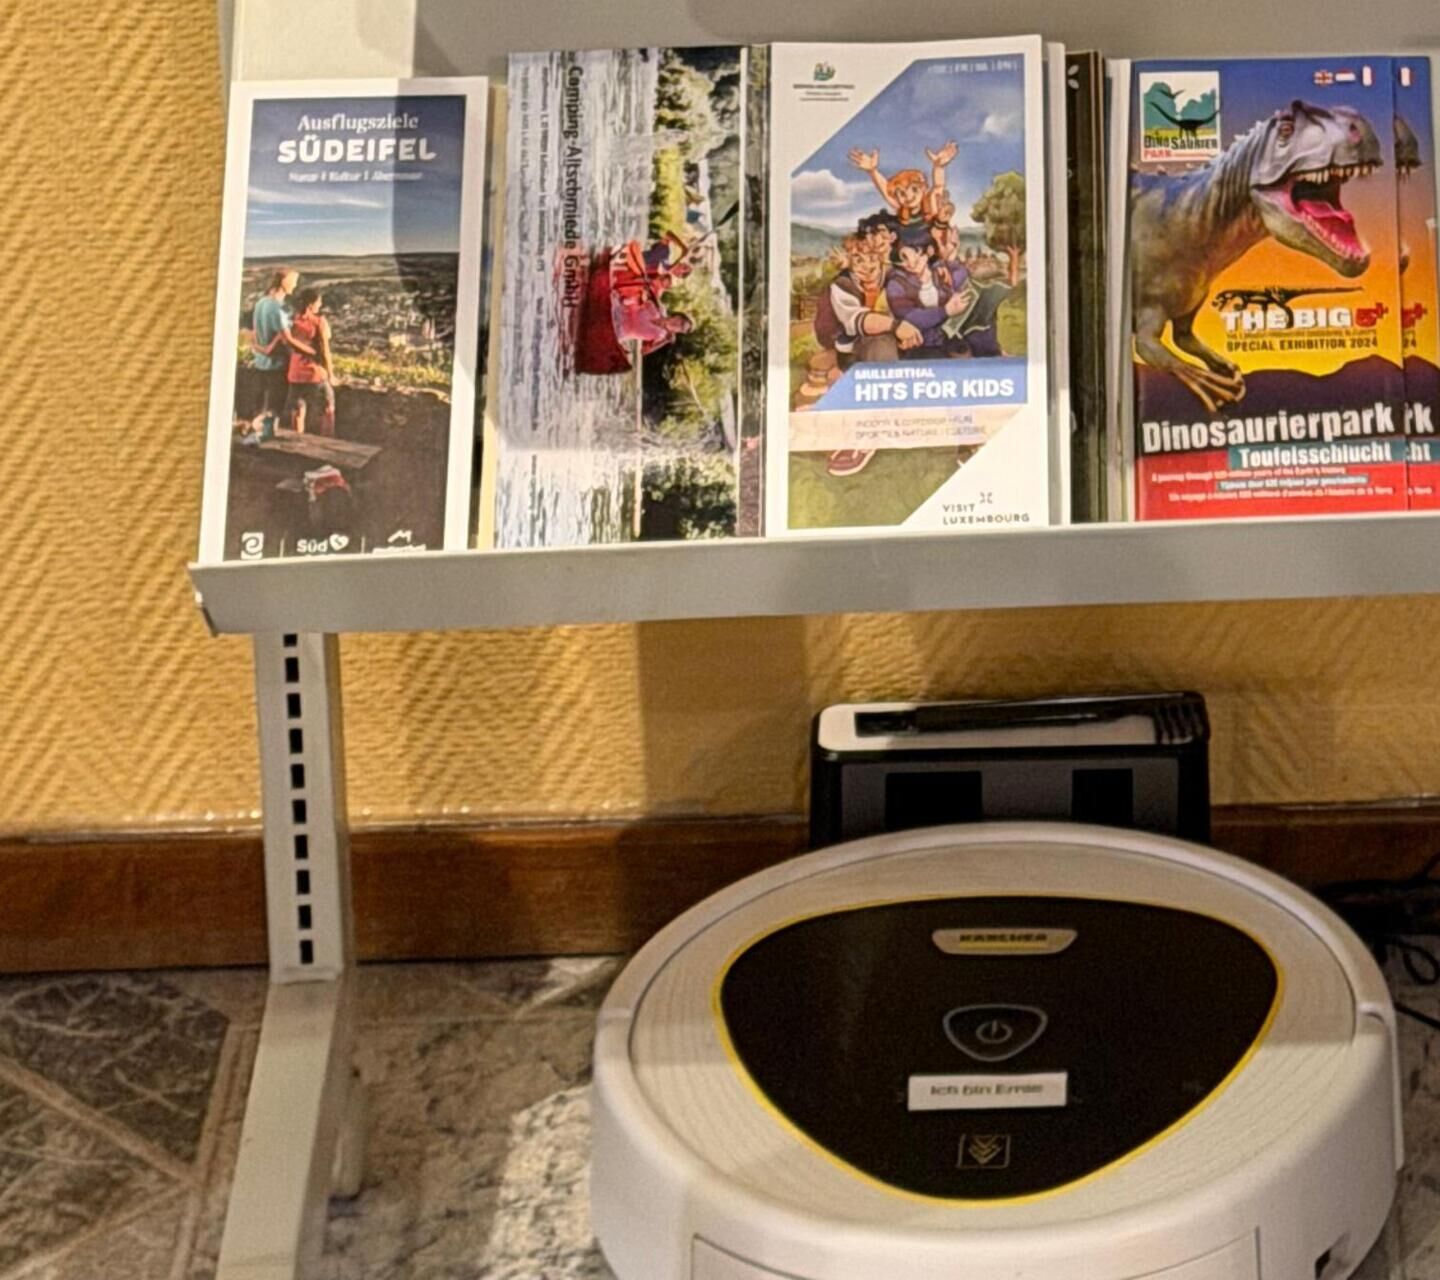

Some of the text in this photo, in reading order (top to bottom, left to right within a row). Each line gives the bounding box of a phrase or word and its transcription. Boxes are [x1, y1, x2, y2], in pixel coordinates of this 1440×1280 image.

[297, 112, 420, 134] Ausflugsziele
[276, 133, 438, 164] SÜDEIFEL
[562, 65, 586, 309] Camping-Altschmiede GmbH
[1220, 303, 1290, 332] THE
[1292, 306, 1352, 329] BIG
[1226, 337, 1379, 353] SPECIAL EXHIBITION 2024
[854, 367, 936, 381] MULLERTHAL
[854, 378, 1015, 402] HITS FOR KIDS
[1141, 401, 1396, 454] Dinosaurierpark
[1238, 440, 1393, 470] Teufelsschlucht
[941, 503, 976, 513] VISIT
[941, 513, 1031, 526] LUXEMBOURG
[296, 538, 329, 553] Süd
